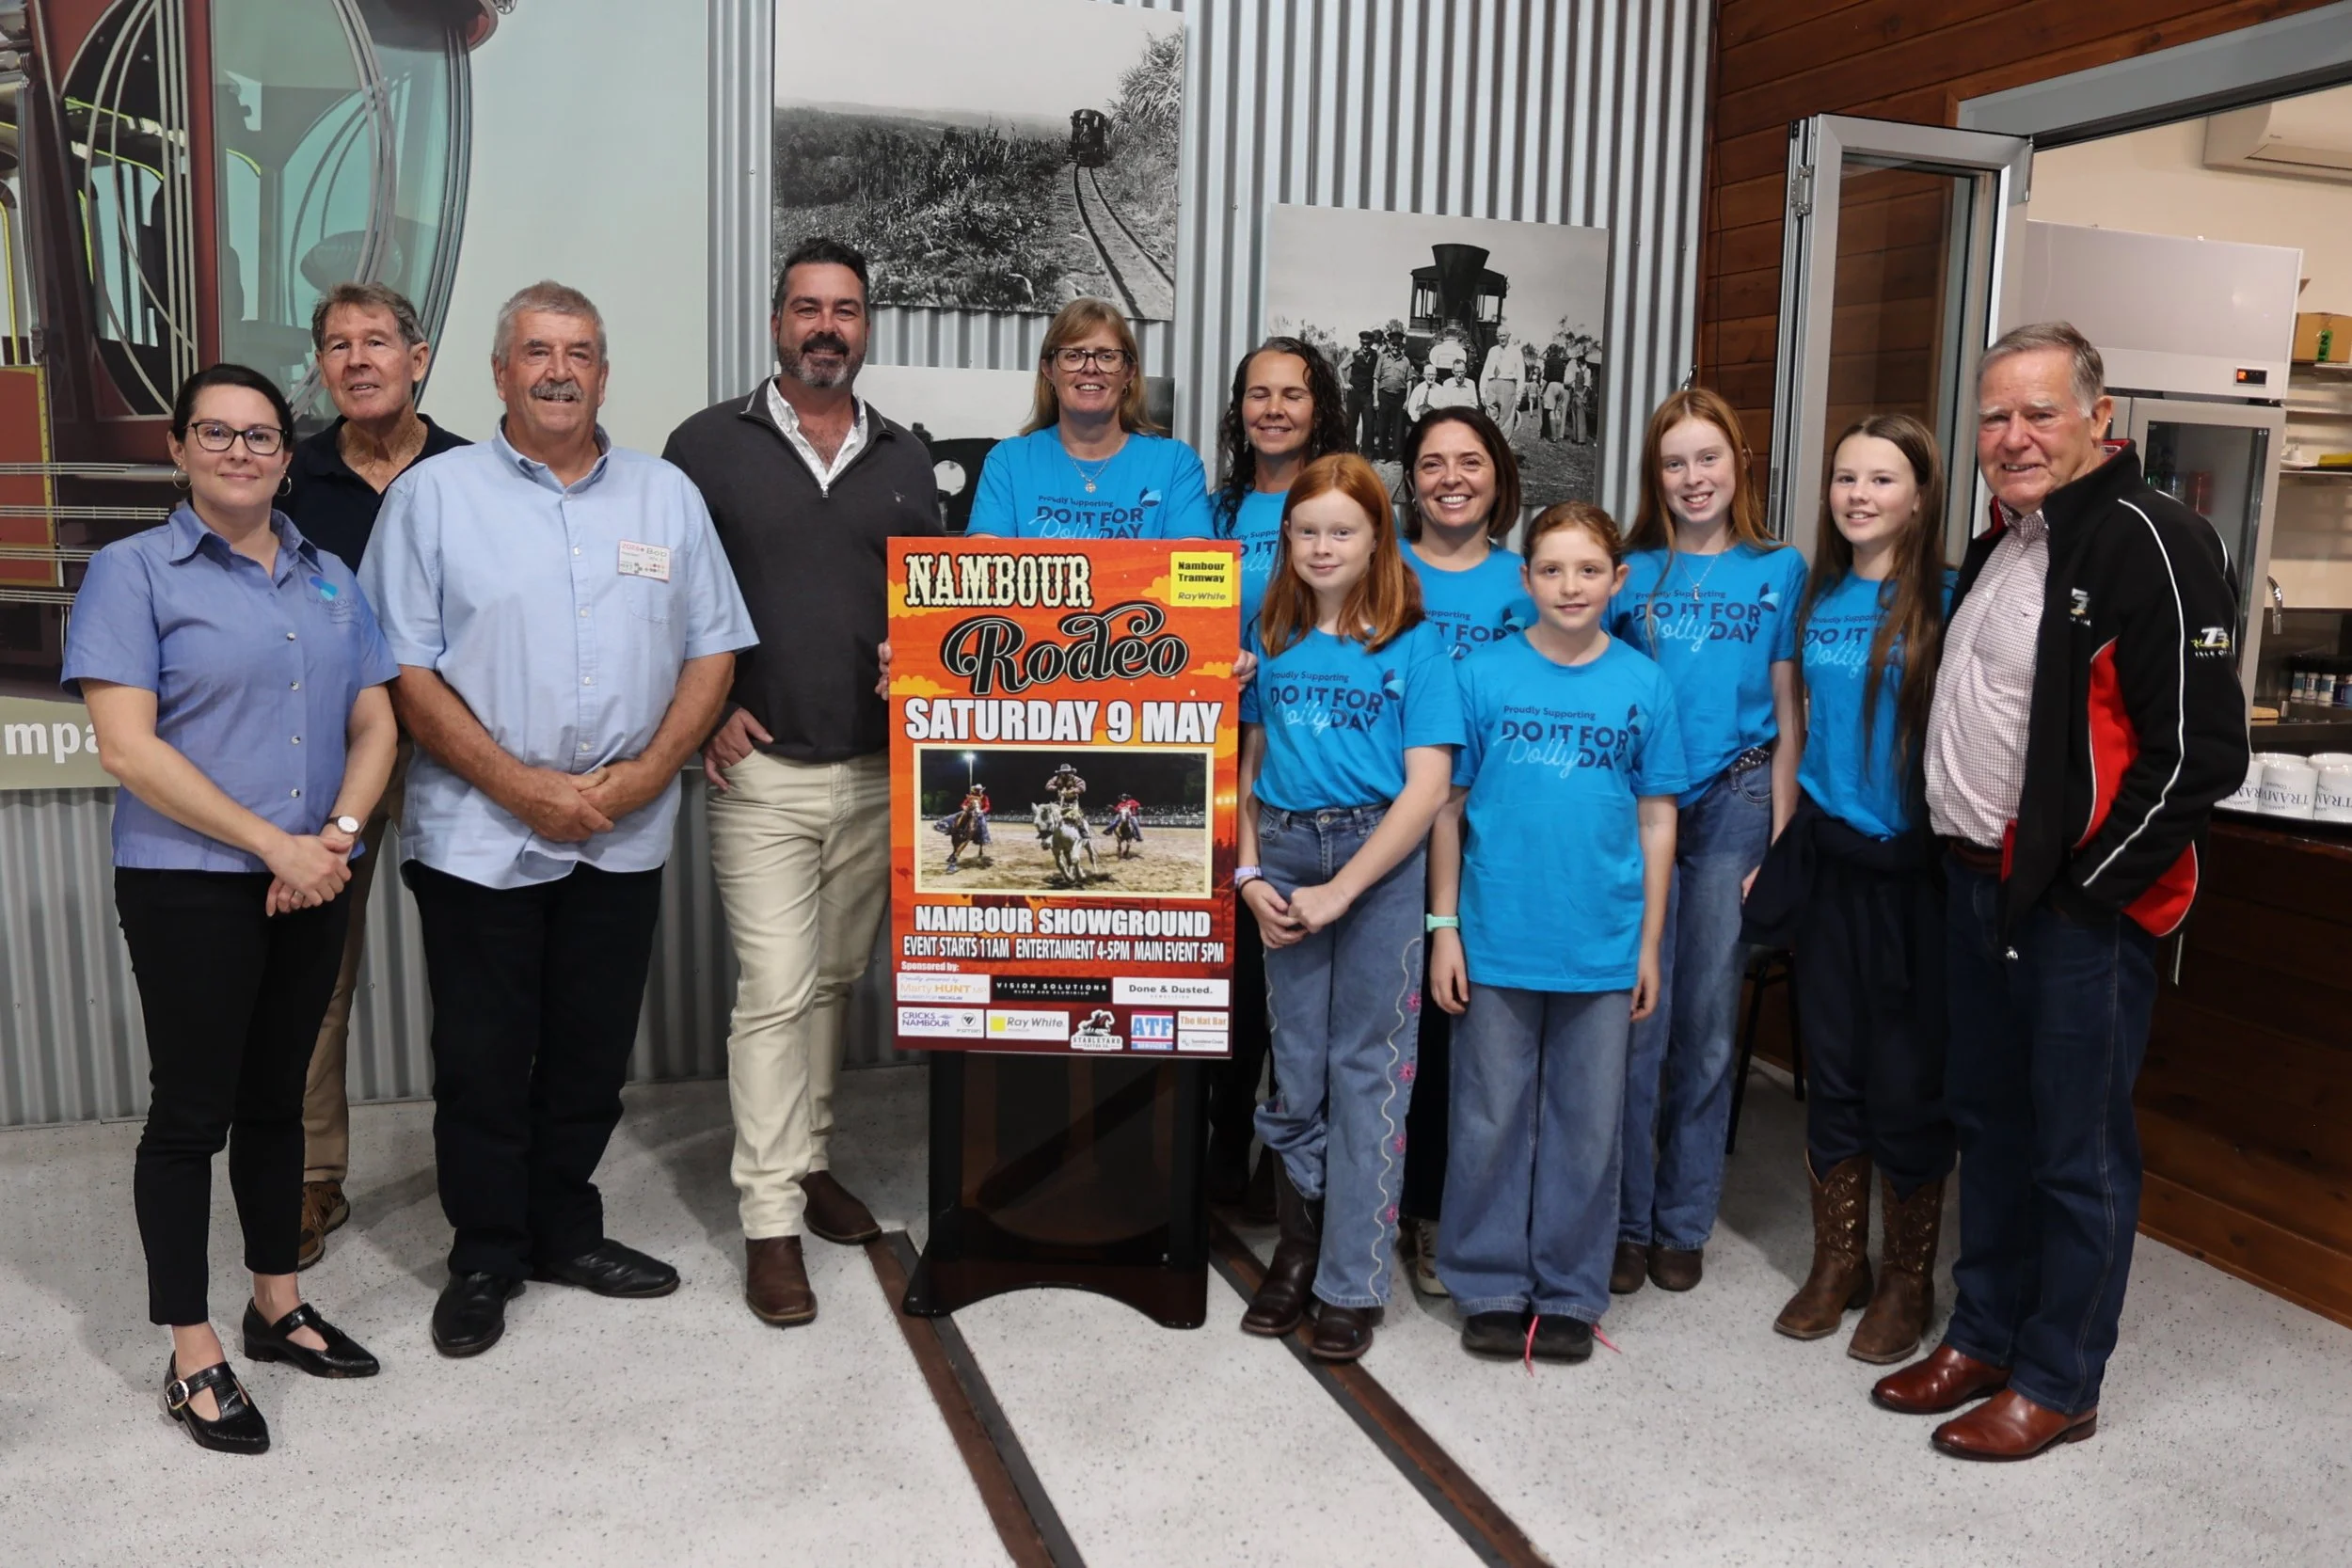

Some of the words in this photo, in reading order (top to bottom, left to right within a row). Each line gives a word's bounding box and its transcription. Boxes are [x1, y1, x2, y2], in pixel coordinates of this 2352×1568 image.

[1038, 495, 1068, 505] Proudly
[1037, 506, 1073, 524] DO
[1076, 511, 1096, 528] IT
[1100, 508, 1144, 527] FOR
[1250, 531, 1280, 539] Suppor
[1255, 540, 1277, 555] IT
[1178, 562, 1225, 571] Nambour
[905, 553, 1092, 609] NAMBOUR
[1178, 573, 1225, 584] Tramway
[1636, 590, 1671, 599] Prodly
[1424, 610, 1470, 621] upporting
[1633, 602, 1674, 621] DO
[1679, 603, 1704, 619] IT
[1710, 603, 1762, 626] FOR
[1708, 621, 1759, 644] DAY
[1805, 628, 1839, 645] DO
[1844, 627, 1867, 644] IT
[941, 601, 1188, 696] Rodeo
[1302, 672, 1349, 683] Supporting
[1270, 685, 1299, 705] DO
[1307, 687, 1328, 705] IT
[1332, 688, 1384, 714] FOR
[1503, 705, 1540, 716] Proudly
[1544, 707, 1596, 721] Supporting
[905, 698, 1099, 742] SATURDAY
[1106, 700, 1133, 742] 9
[1141, 701, 1222, 743] MAY
[1330, 709, 1378, 733] DAY
[1502, 721, 1543, 742] DO
[1549, 723, 1573, 744] IT
[1579, 726, 1629, 751] FOR
[914, 905, 1033, 933] NAMBOUR
[1038, 908, 1211, 938] SHOWGROUND
[903, 936, 938, 956] EVENT
[940, 936, 977, 958] STARTS
[980, 938, 1009, 958] 11AM
[1097, 940, 1129, 960] 4-5PM
[1134, 942, 1163, 961] MAIN
[1165, 942, 1199, 962] EVENT
[1200, 942, 1224, 962] 5PM
[901, 961, 946, 972] Sponsored
[947, 962, 960, 972] by:
[900, 983, 931, 994] Marty
[934, 985, 971, 994] HUNT
[1043, 983, 1107, 991] SOLUTIONS
[1129, 984, 1156, 993] Done
[1159, 985, 1168, 993] &
[1171, 985, 1214, 994] Dusted.
[902, 1011, 935, 1020] CRICKS
[1180, 1016, 1195, 1024] The
[902, 1019, 950, 1027] NAMBOUR
[1007, 1017, 1028, 1028] Ray
[1132, 1016, 1173, 1037] ATF
[1073, 1037, 1121, 1045] STABLEYARD
